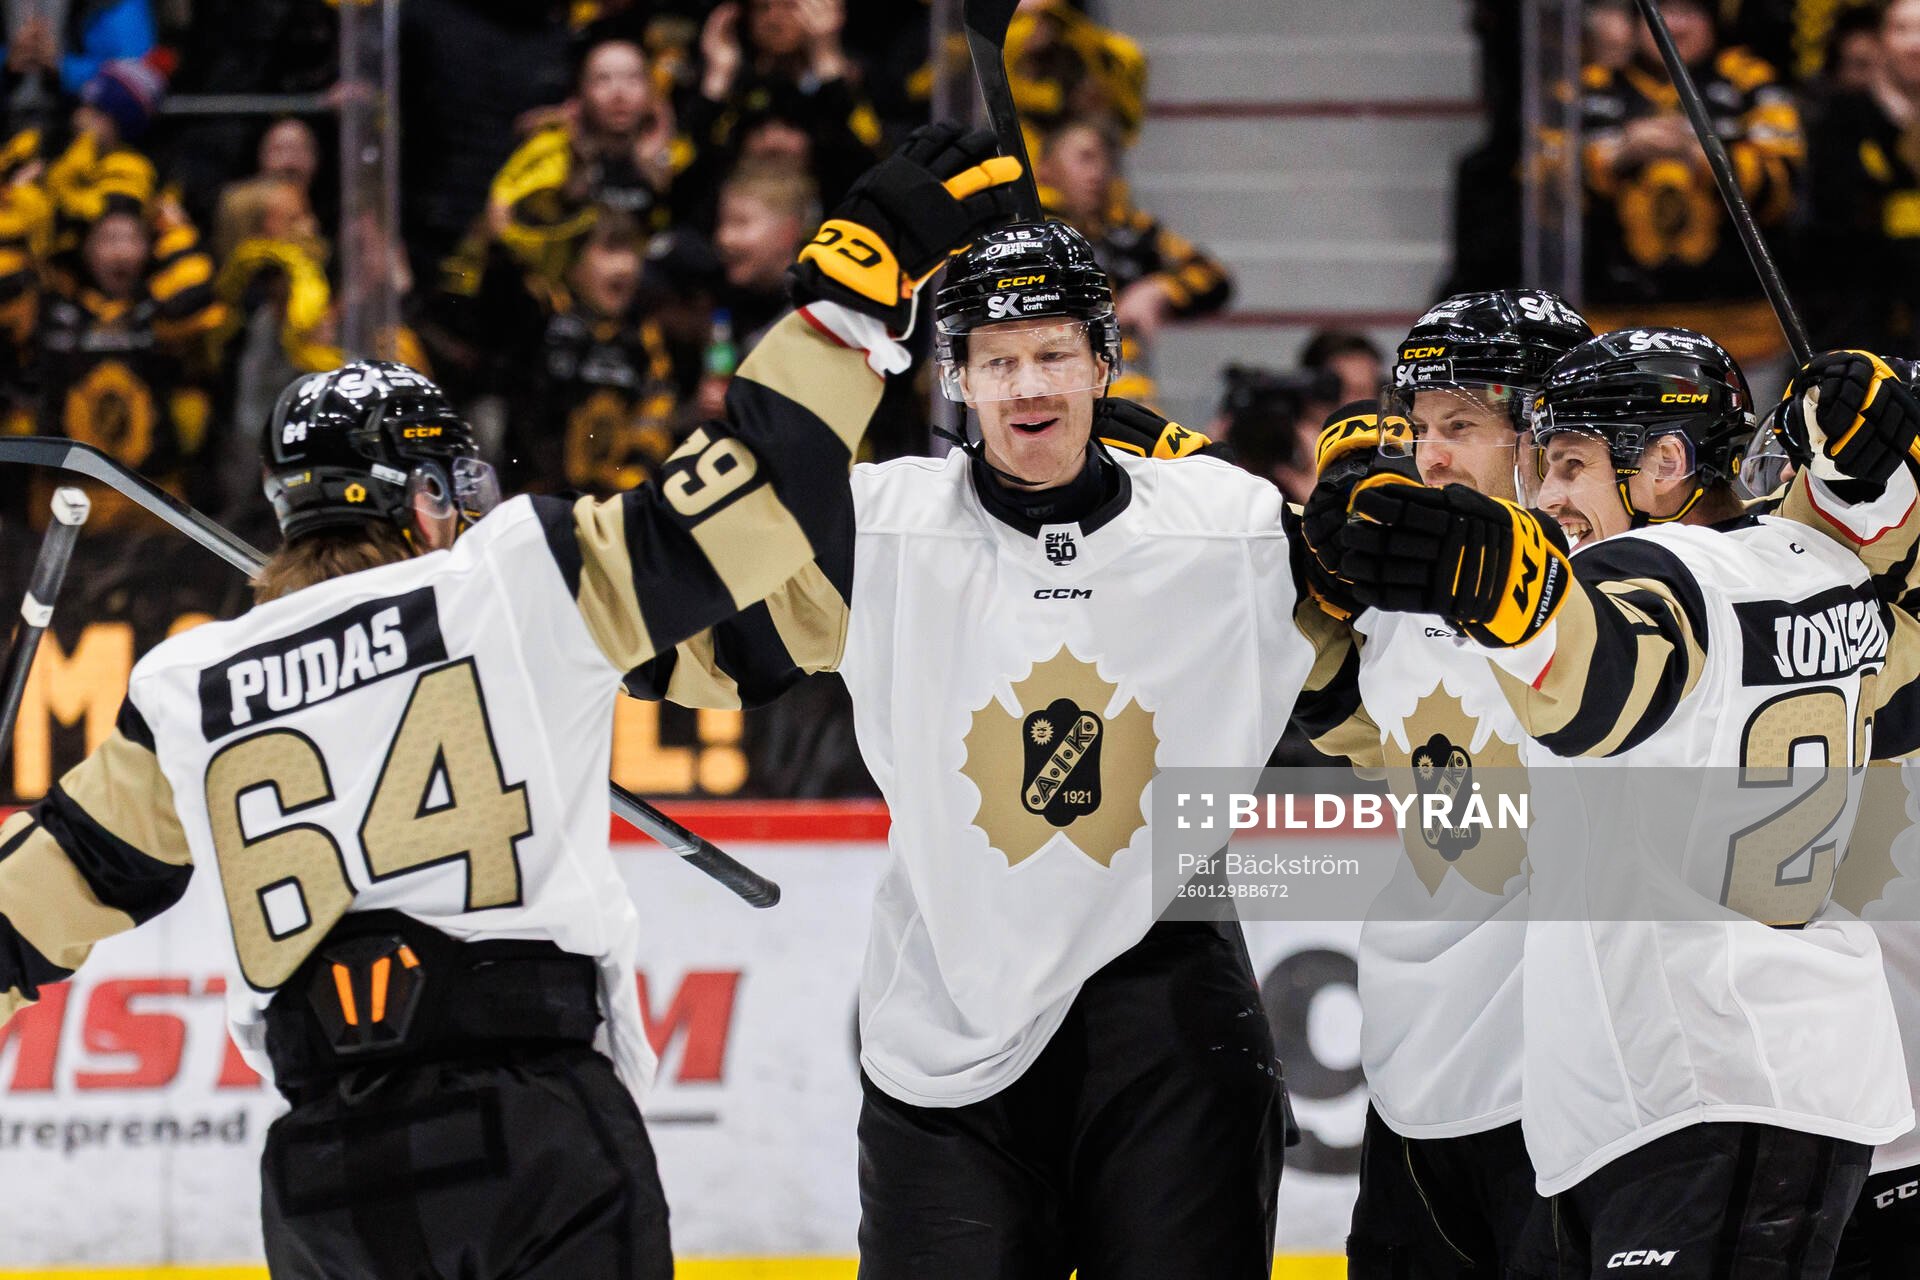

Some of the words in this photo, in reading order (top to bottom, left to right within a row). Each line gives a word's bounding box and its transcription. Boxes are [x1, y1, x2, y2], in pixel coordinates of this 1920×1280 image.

[1004, 231, 1031, 241] 15
[997, 275, 1046, 289] CCM
[988, 293, 1022, 318] SK
[1023, 293, 1060, 304] Skellefteå
[1023, 302, 1043, 311] Kraft
[1629, 331, 1670, 351] SK
[1403, 347, 1446, 360] CCM
[1395, 364, 1417, 387] SK
[1661, 393, 1709, 404] CCM
[282, 421, 308, 444] 64
[403, 427, 442, 439] CCM
[1046, 532, 1074, 543] SHL
[1045, 542, 1077, 562] 50
[1034, 588, 1093, 599] CCM
[227, 605, 408, 726] PUDAS
[1063, 791, 1092, 804] 1921
[204, 655, 533, 994] 64
[0, 1111, 246, 1153] reprenad
[1606, 1250, 1680, 1269] CCM
